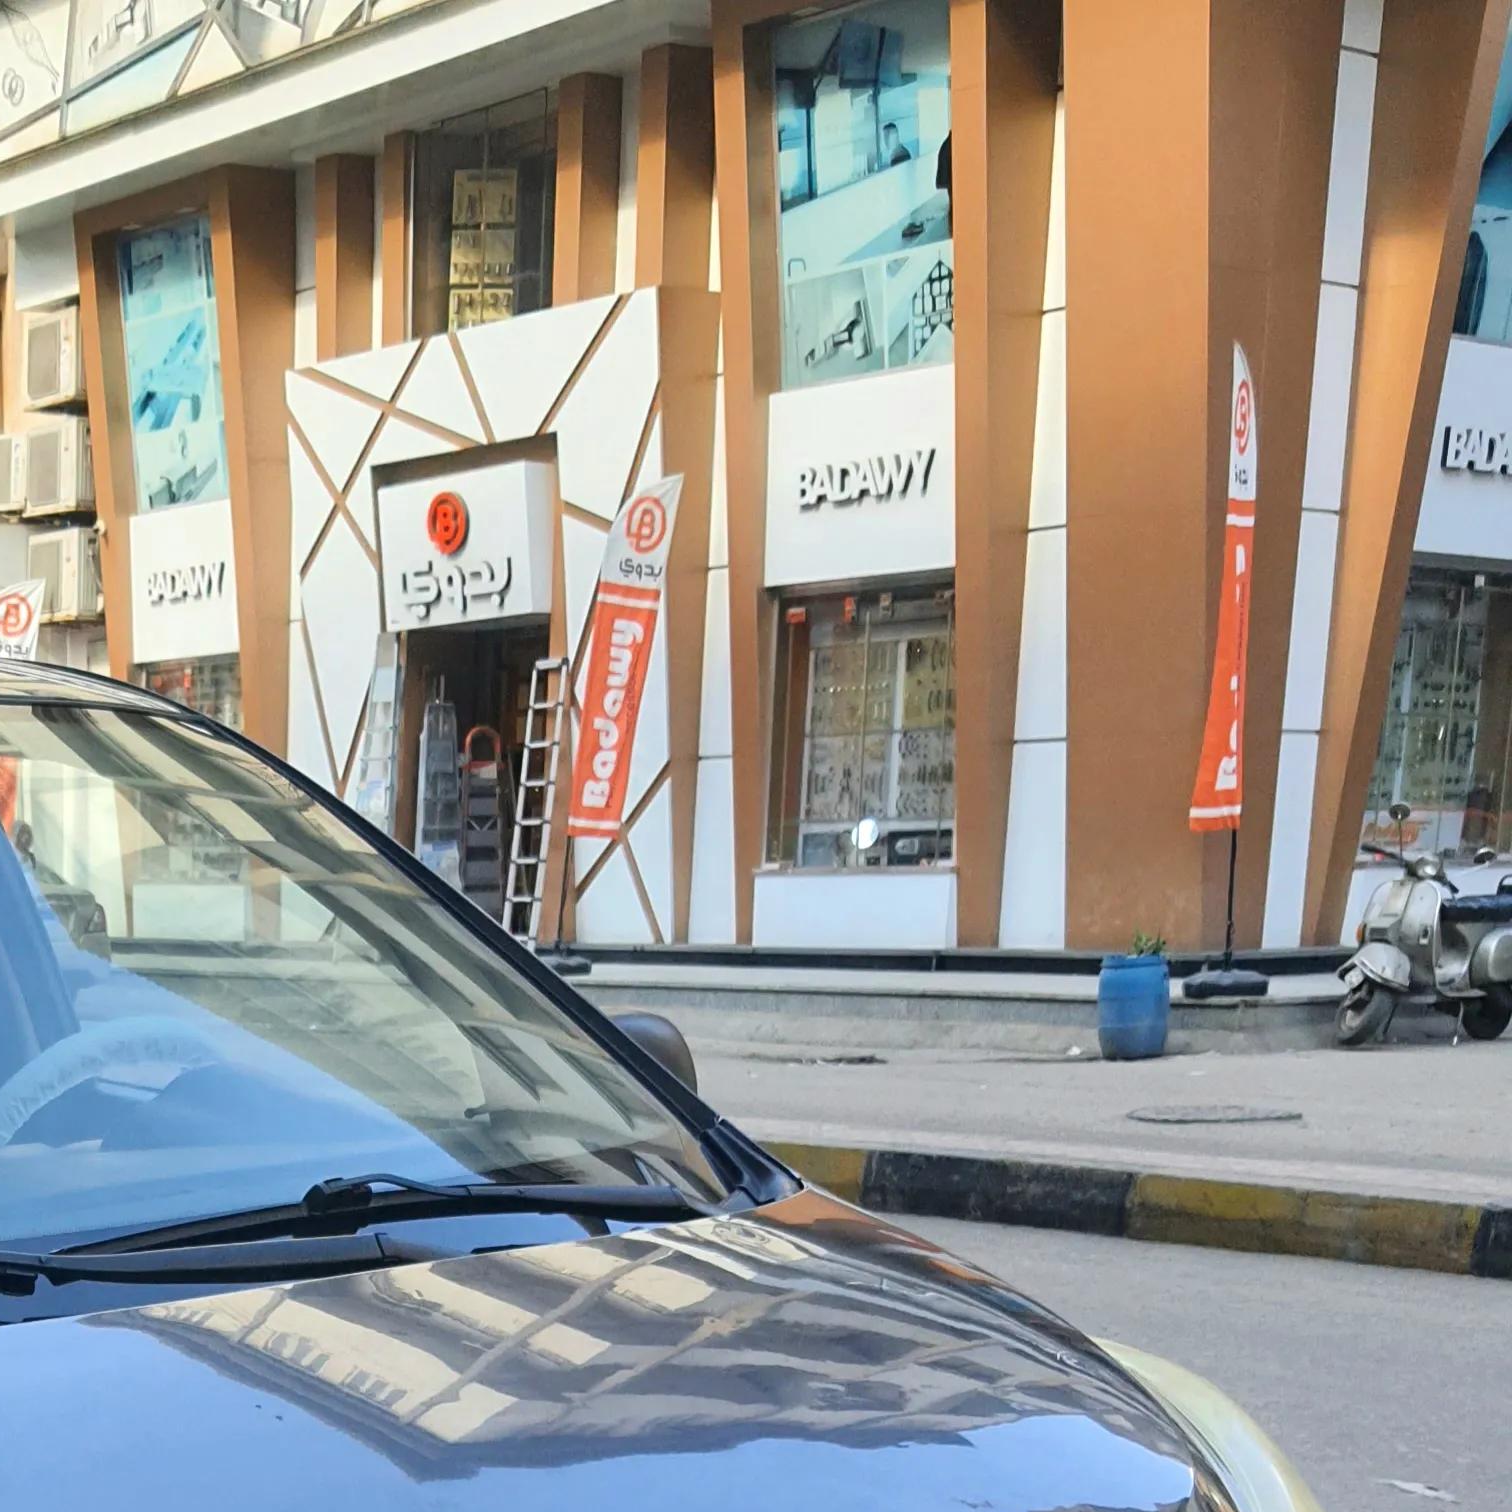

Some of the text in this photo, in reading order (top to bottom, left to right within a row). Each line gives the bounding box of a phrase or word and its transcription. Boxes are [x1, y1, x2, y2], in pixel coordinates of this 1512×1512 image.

[794, 447, 937, 513] BADAWY
[143, 561, 225, 607] BADAWY
[399, 556, 512, 620] بدوي
[619, 558, 663, 582] بدوي
[581, 618, 645, 808] Badawy
